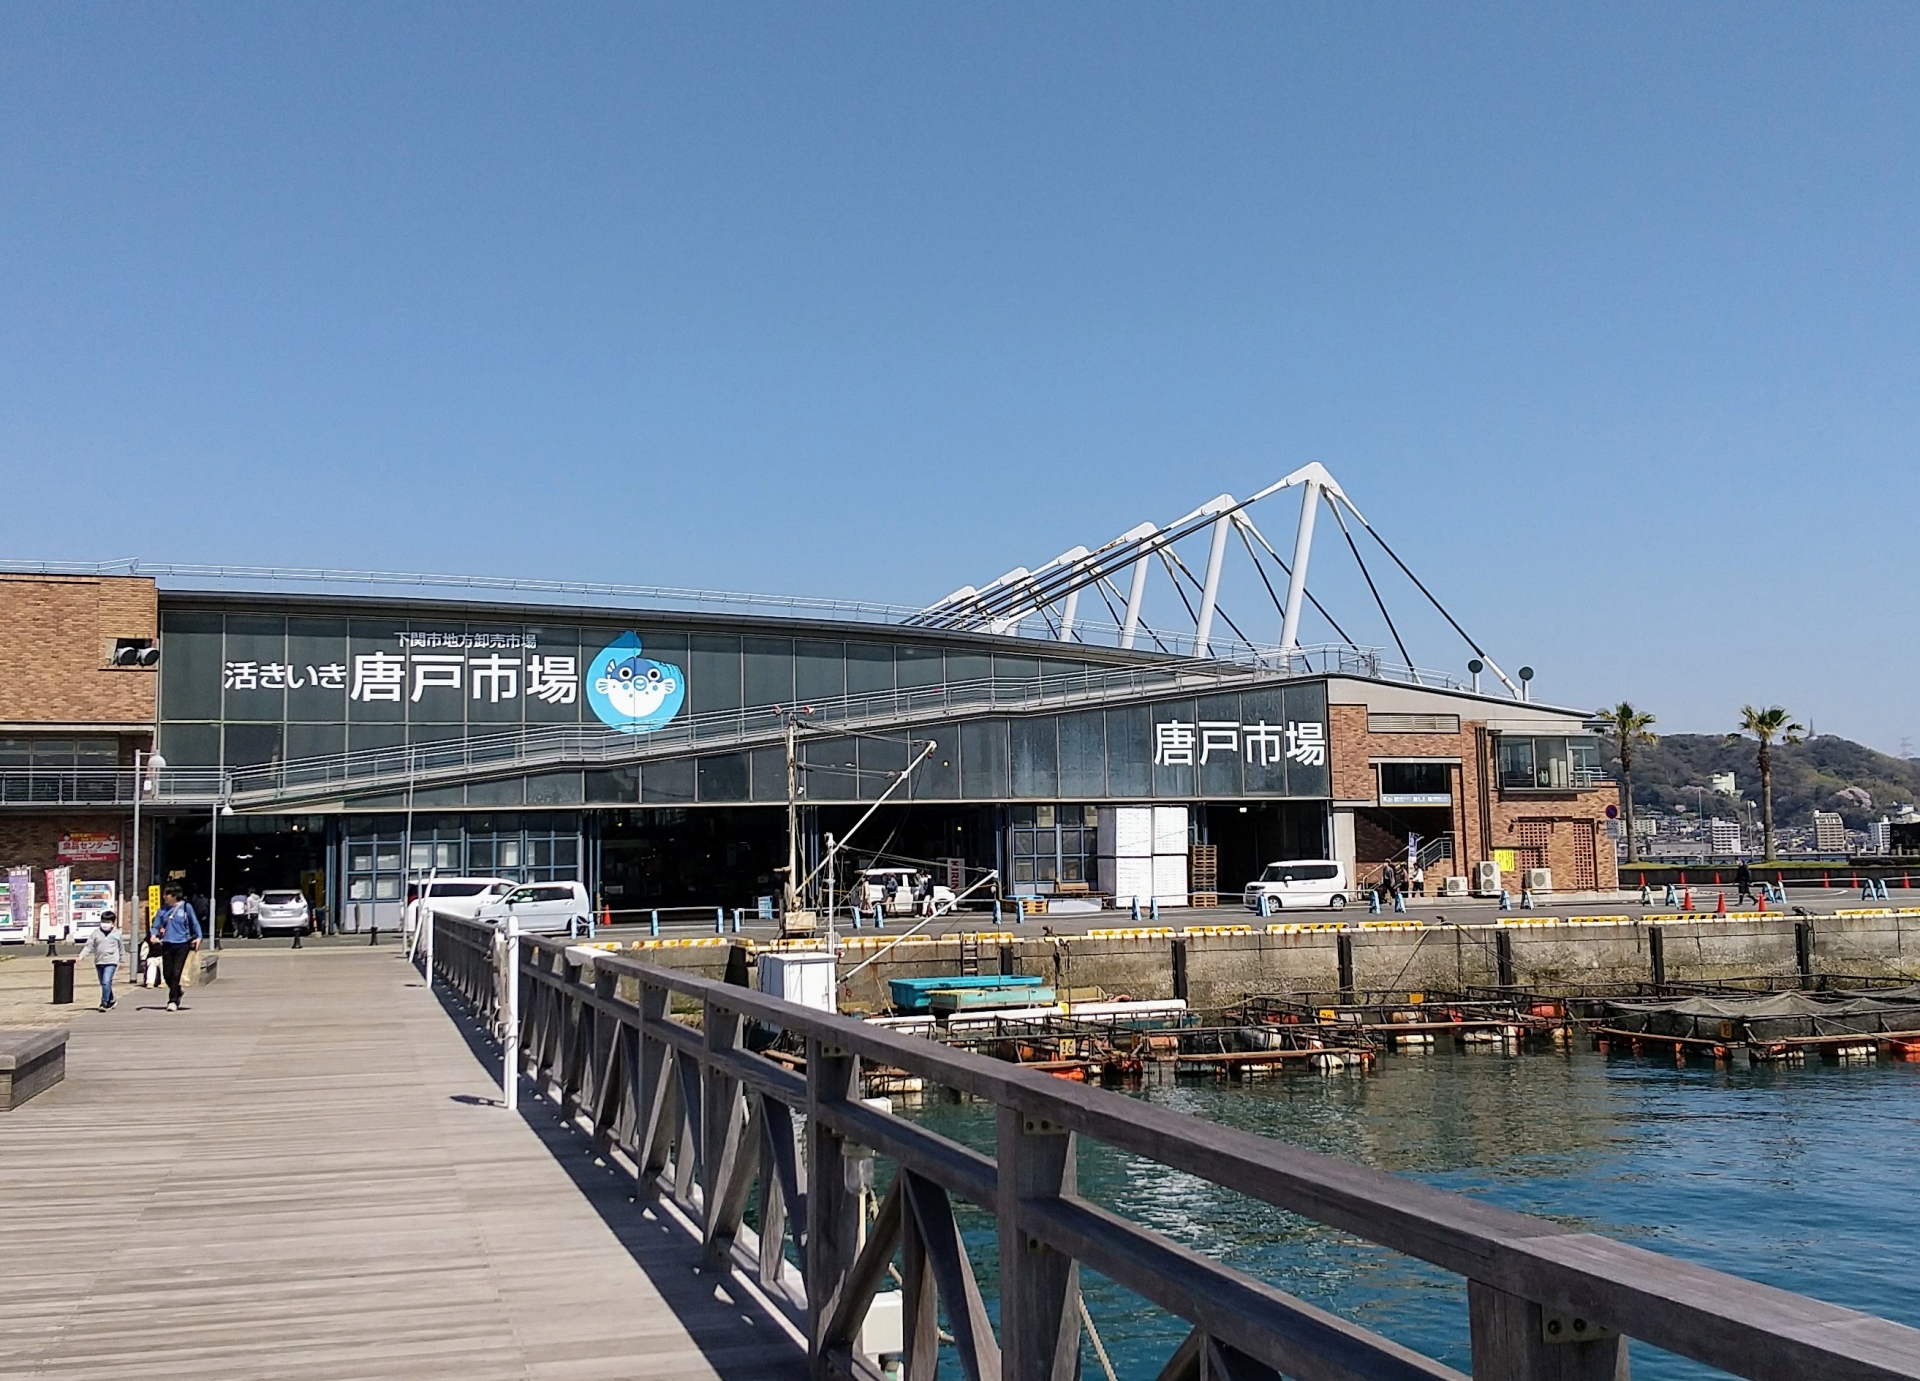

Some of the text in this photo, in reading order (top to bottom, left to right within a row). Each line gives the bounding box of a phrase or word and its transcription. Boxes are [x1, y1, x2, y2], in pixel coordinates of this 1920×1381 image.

[394, 631, 537, 649] 下関市地方卸売市場
[224, 651, 578, 704] 活きいき 唐戸市場
[1154, 719, 1326, 766] 唐戸市場
[950, 860, 960, 890] KIRIN
[1062, 1041, 1074, 1054] 16
